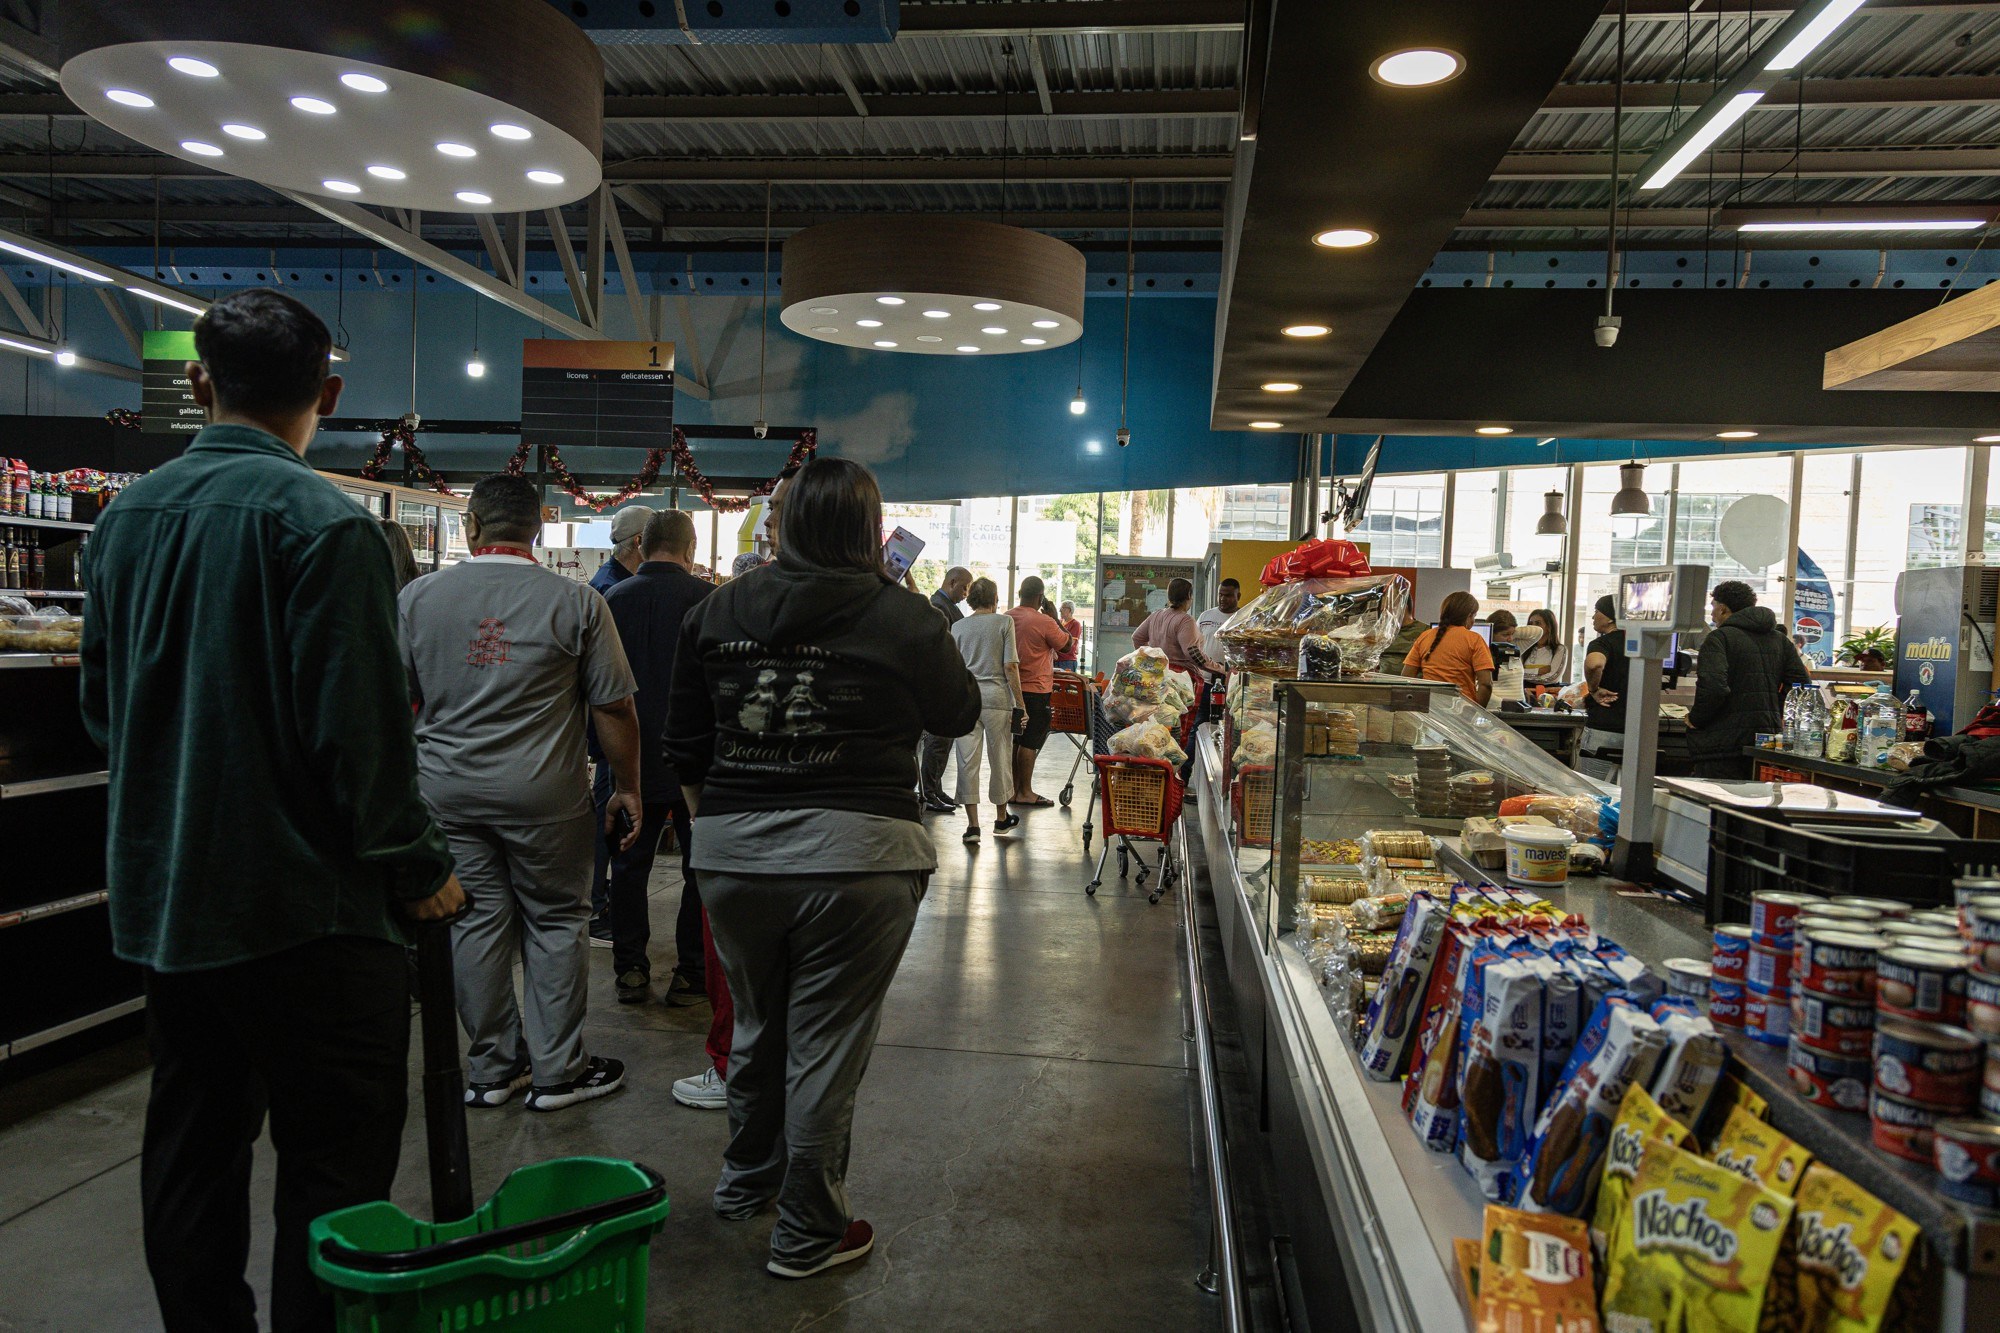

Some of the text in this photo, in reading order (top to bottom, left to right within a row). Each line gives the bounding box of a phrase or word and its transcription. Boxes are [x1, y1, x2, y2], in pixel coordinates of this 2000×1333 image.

[649, 346, 661, 367] 1
[566, 372, 589, 380] licores
[621, 372, 664, 380] delicatessen
[179, 407, 204, 416] galletas
[170, 422, 203, 430] infusiones
[548, 507, 558, 522] 3
[941, 532, 1006, 541] MCAIBO
[1106, 564, 1145, 572] CARTELERA
[1806, 597, 1828, 605] PURO
[1799, 602, 1829, 611] SABOR
[1797, 625, 1822, 635] PEPSI
[468, 640, 512, 652] URGENT
[1905, 637, 1952, 661] maltín
[466, 653, 496, 665] CARE
[722, 740, 844, 765] Social Club
[1525, 848, 1567, 860] mavesa
[1637, 1191, 1735, 1261] Nachos
